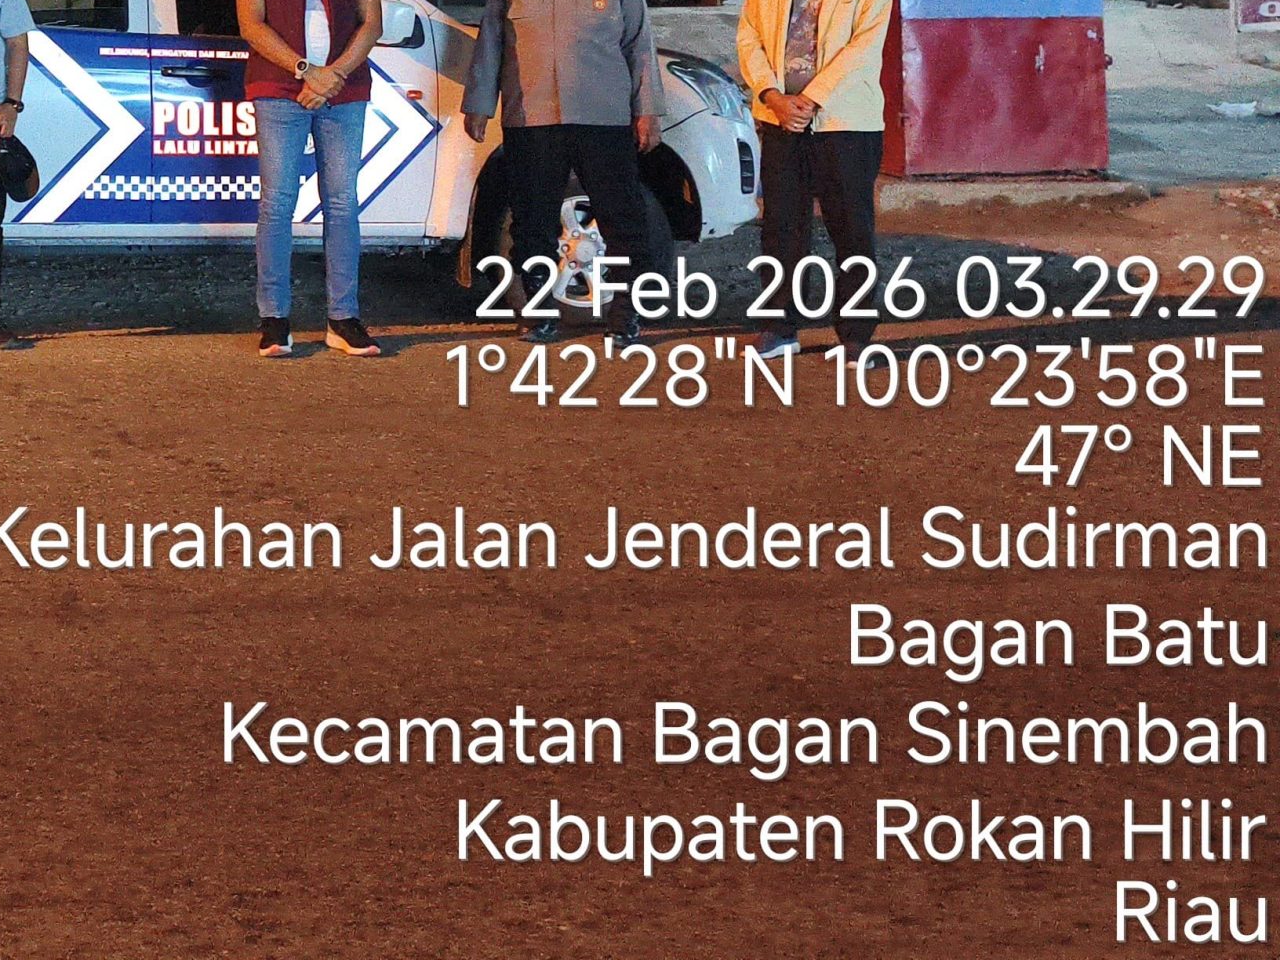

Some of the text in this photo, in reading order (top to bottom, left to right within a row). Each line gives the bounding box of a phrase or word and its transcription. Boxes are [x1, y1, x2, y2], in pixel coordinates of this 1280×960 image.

[153, 101, 257, 137] POLIS
[153, 140, 259, 156] LALU LINTA
